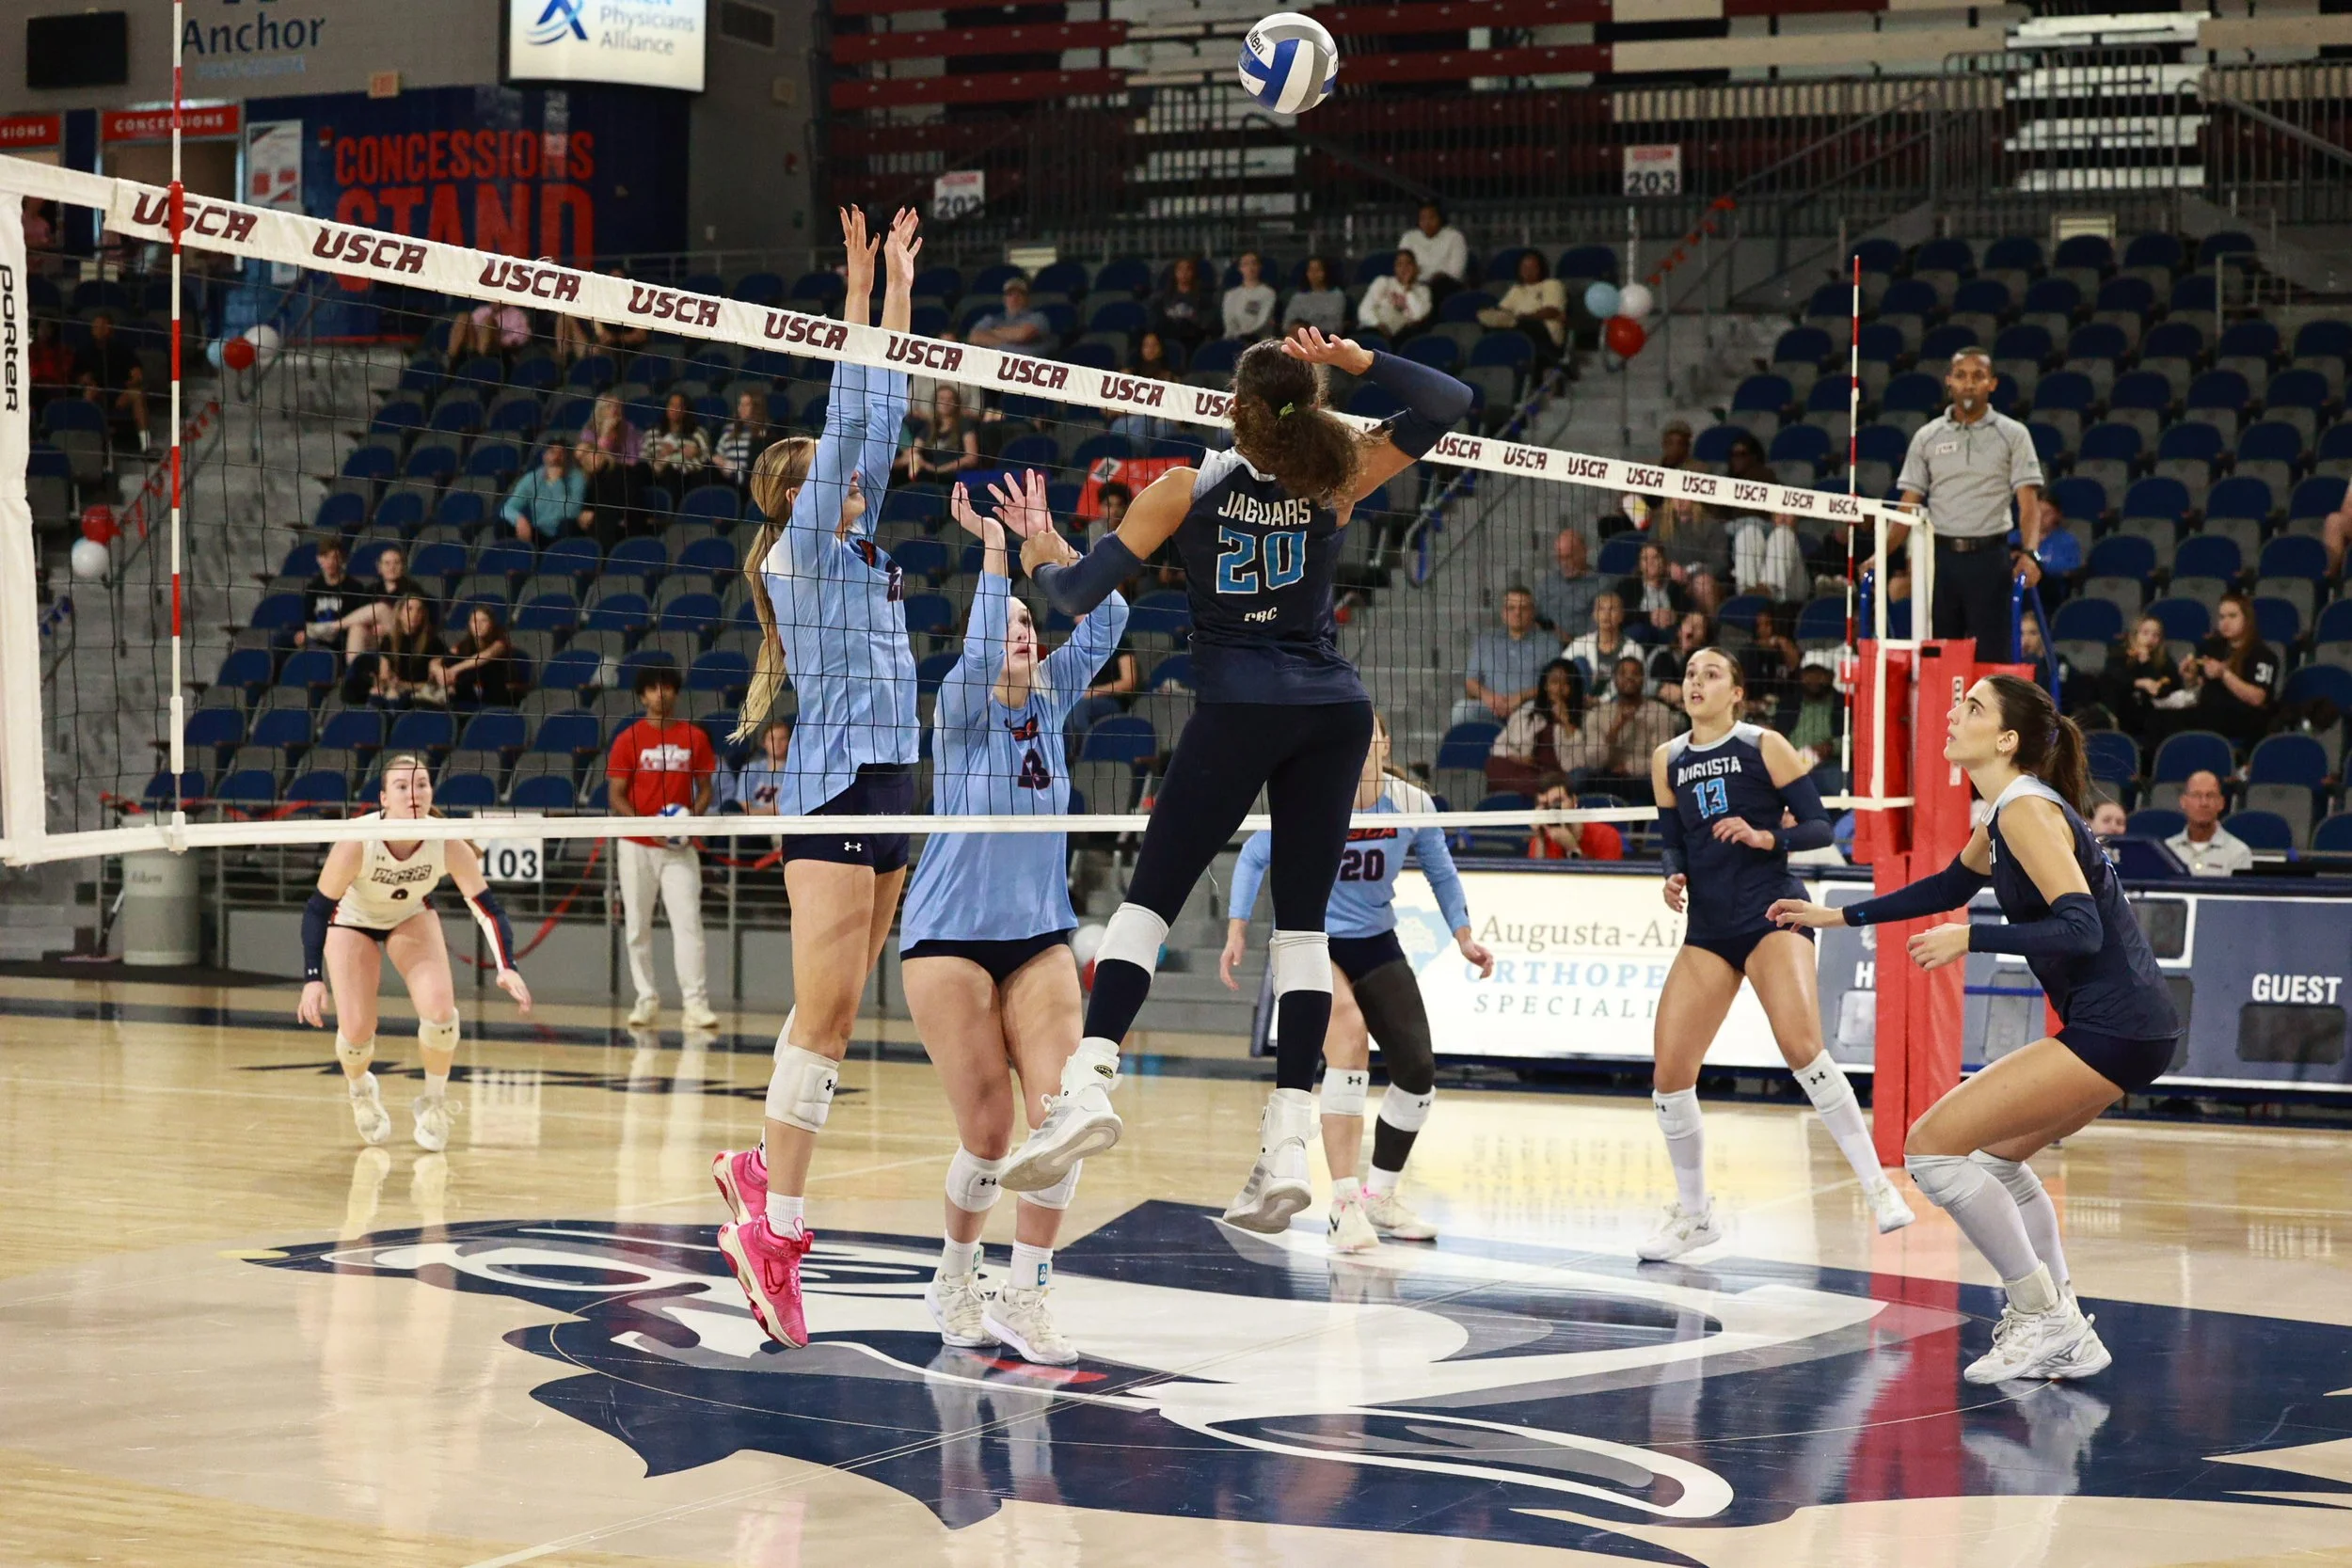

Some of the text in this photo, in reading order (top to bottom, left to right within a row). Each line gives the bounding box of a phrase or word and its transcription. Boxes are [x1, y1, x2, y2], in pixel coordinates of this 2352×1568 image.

[182, 11, 326, 55] Anchor
[599, 6, 695, 32] Physicians
[600, 31, 675, 55] Alliance
[1248, 30, 1264, 55] lten
[115, 113, 224, 133] CONCESSIONS
[335, 130, 595, 185] CONCESSIONS
[1628, 170, 1676, 197] 203
[132, 191, 259, 243] USCA
[312, 227, 428, 274] USCA
[478, 258, 581, 301] USCA
[628, 285, 721, 327] USCA
[764, 311, 849, 351] USCA
[885, 335, 963, 372] USCA
[996, 356, 1070, 389] USCA
[1100, 375, 1166, 407] USCA
[1436, 436, 1483, 461] USCA
[1503, 446, 1549, 470] USCA
[1567, 456, 1609, 480] USCA
[1626, 467, 1665, 489] USCA
[1681, 475, 1717, 496] USCA
[1733, 483, 1769, 502] USCA
[1782, 490, 1815, 510] USCA
[1217, 490, 1311, 527] JAGUARS
[1216, 525, 1308, 594] 20
[2254, 662, 2274, 685] 31
[1692, 777, 1729, 819] 13
[483, 848, 538, 879] 103
[1339, 848, 1385, 881] 20
[2251, 973, 2344, 1005] GUEST
